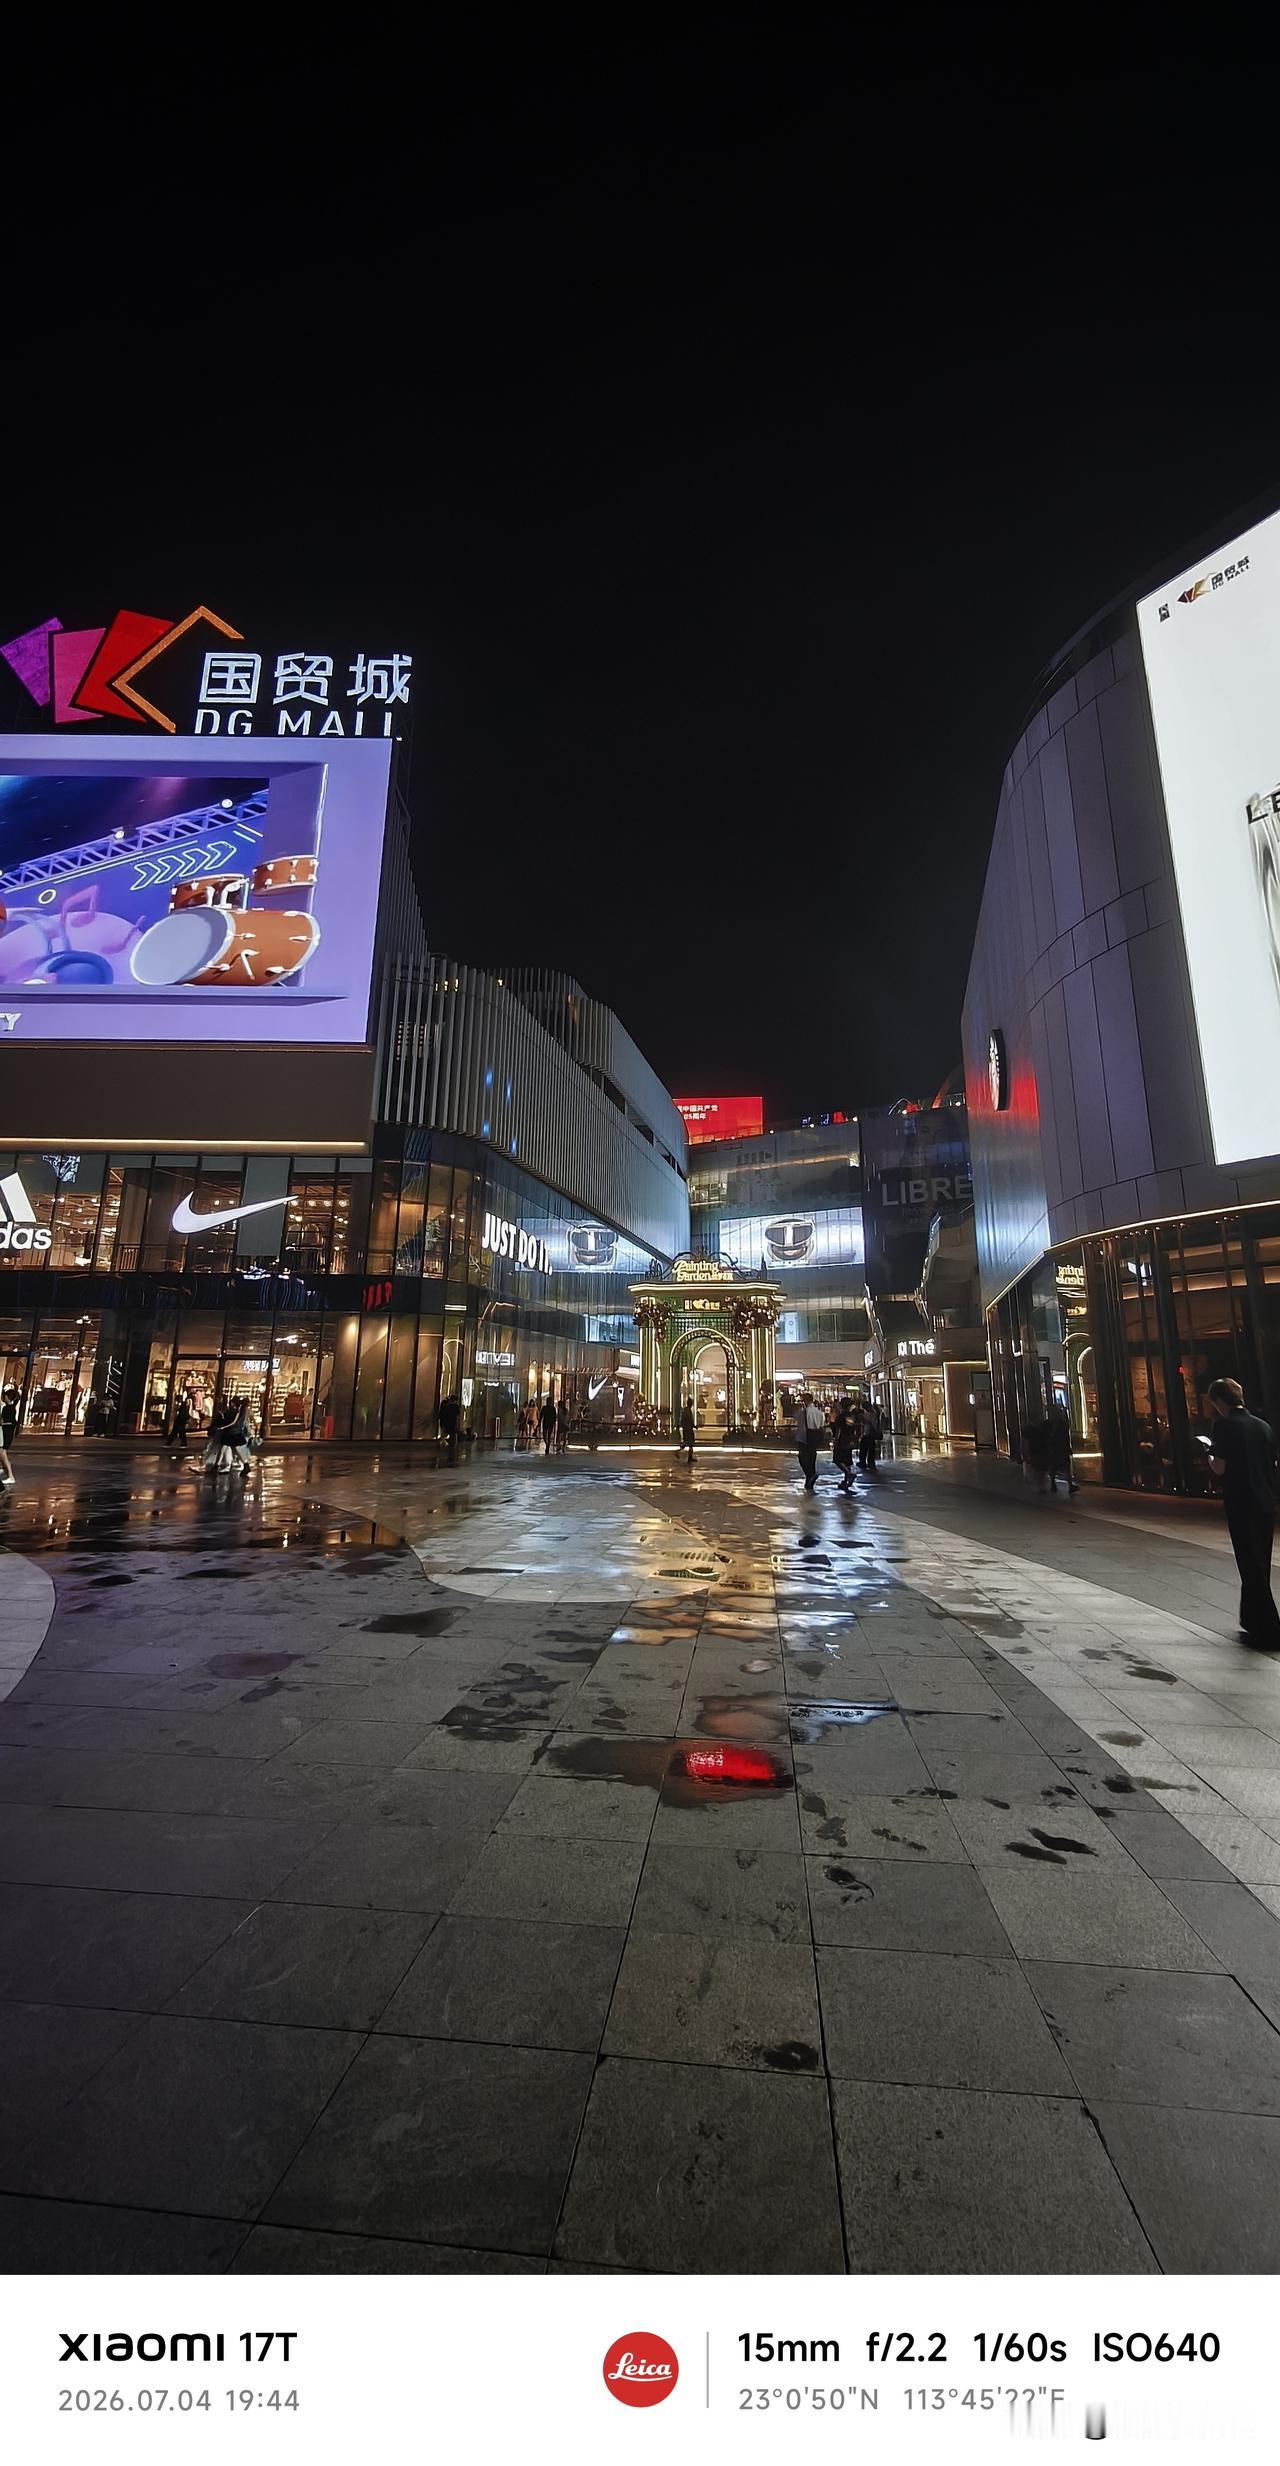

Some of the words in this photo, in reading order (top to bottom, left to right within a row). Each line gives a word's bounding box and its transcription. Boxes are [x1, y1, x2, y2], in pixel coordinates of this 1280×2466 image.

[198, 652, 413, 706] 国贸城
[194, 708, 254, 735] DG
[881, 1174, 972, 1206] LIBRE
[482, 1212, 517, 1259] JUST
[518, 1228, 537, 1269] DO
[671, 1260, 719, 1274] Painting
[676, 1271, 711, 1282] Garden
[908, 1338, 935, 1356] Thé
